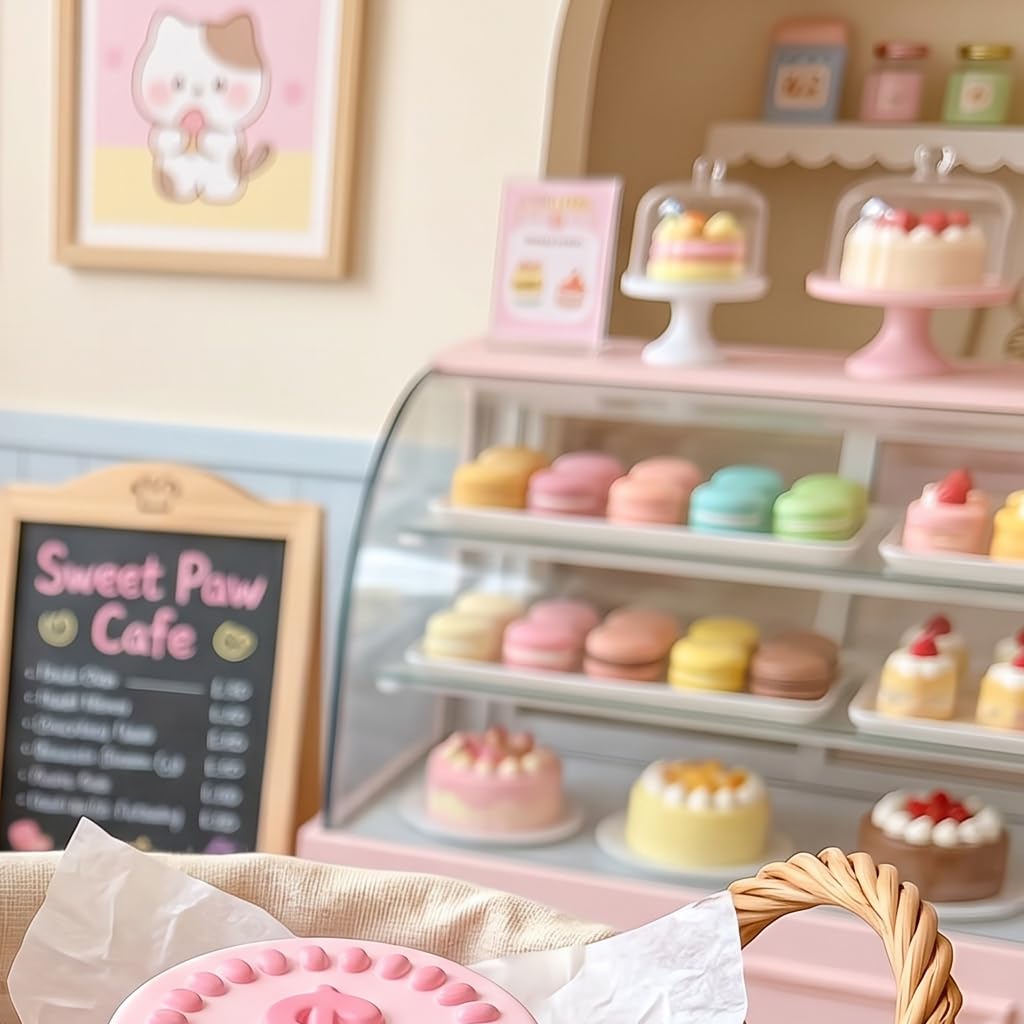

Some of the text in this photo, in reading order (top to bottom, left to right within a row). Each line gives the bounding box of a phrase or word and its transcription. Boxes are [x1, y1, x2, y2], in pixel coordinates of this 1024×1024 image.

[34, 539, 268, 610] Sweet Paw
[91, 602, 198, 660] Cafe
